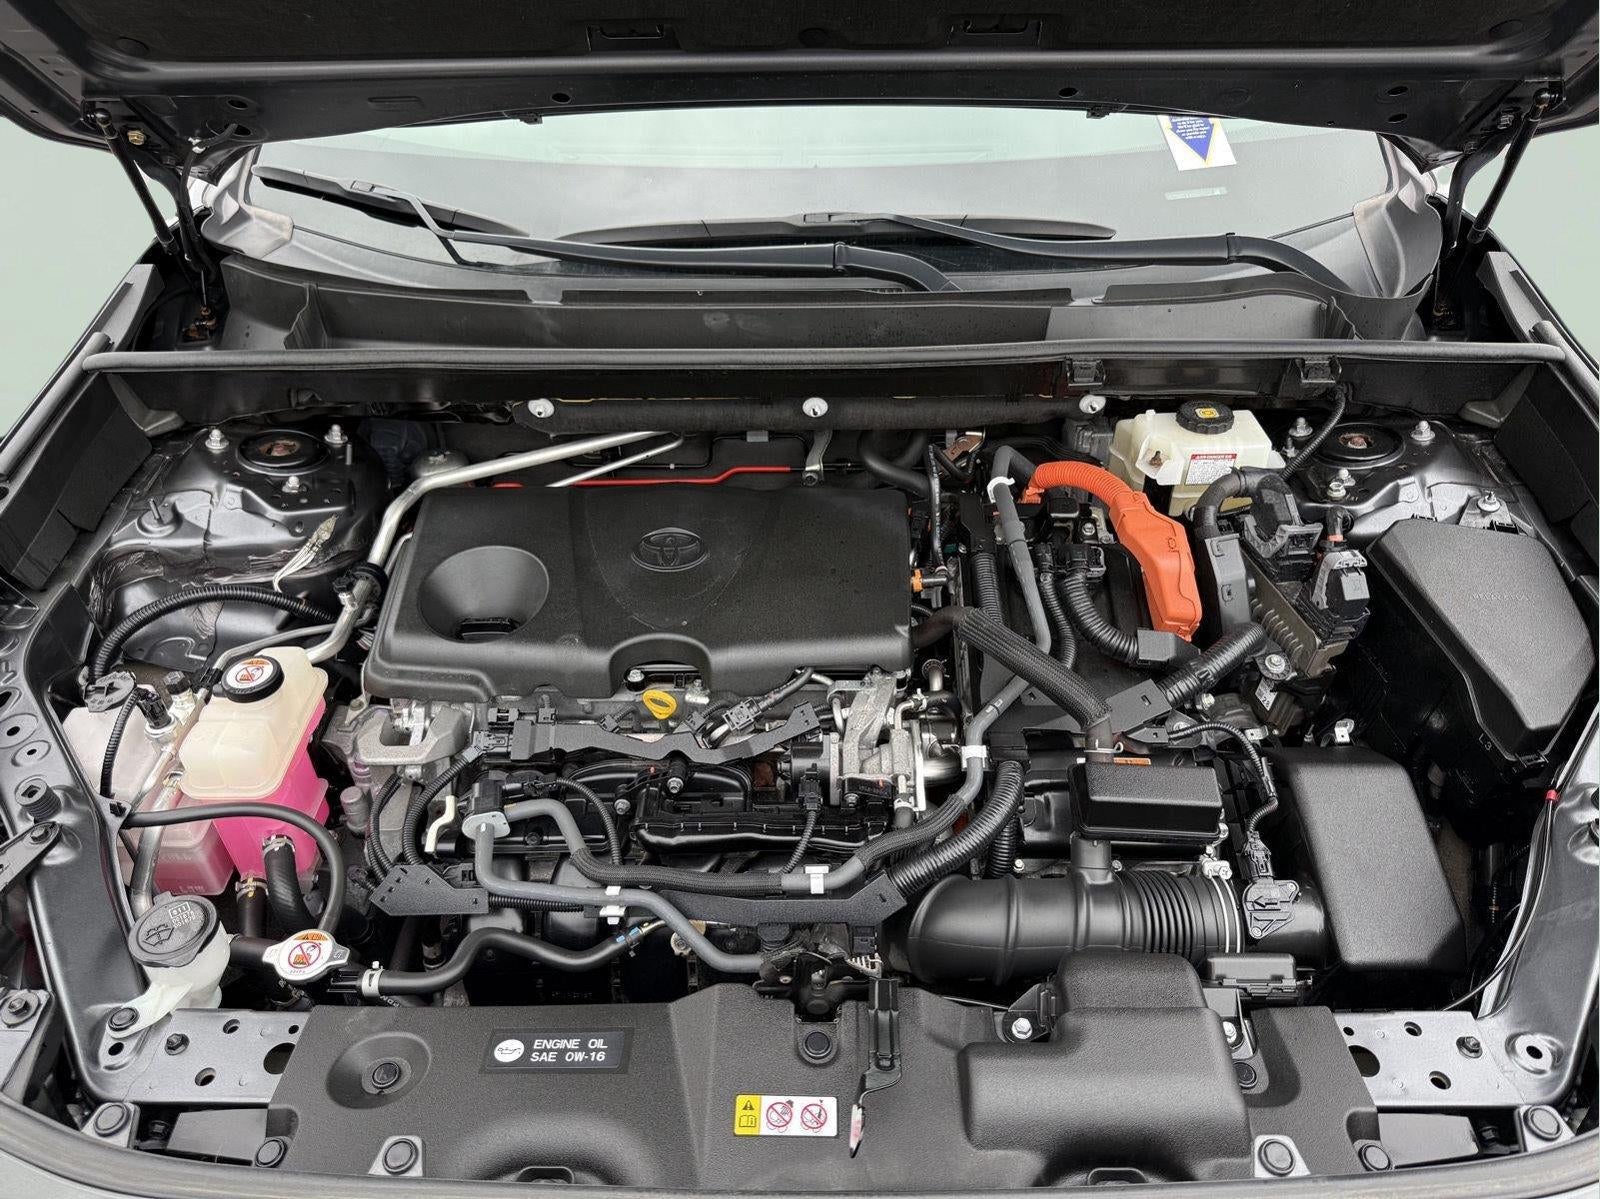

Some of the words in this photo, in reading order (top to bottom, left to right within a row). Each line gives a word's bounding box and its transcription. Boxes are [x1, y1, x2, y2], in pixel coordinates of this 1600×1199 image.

[533, 1038, 581, 1049] ENGINE
[588, 1038, 608, 1049] OIL
[530, 1051, 558, 1062] SAE
